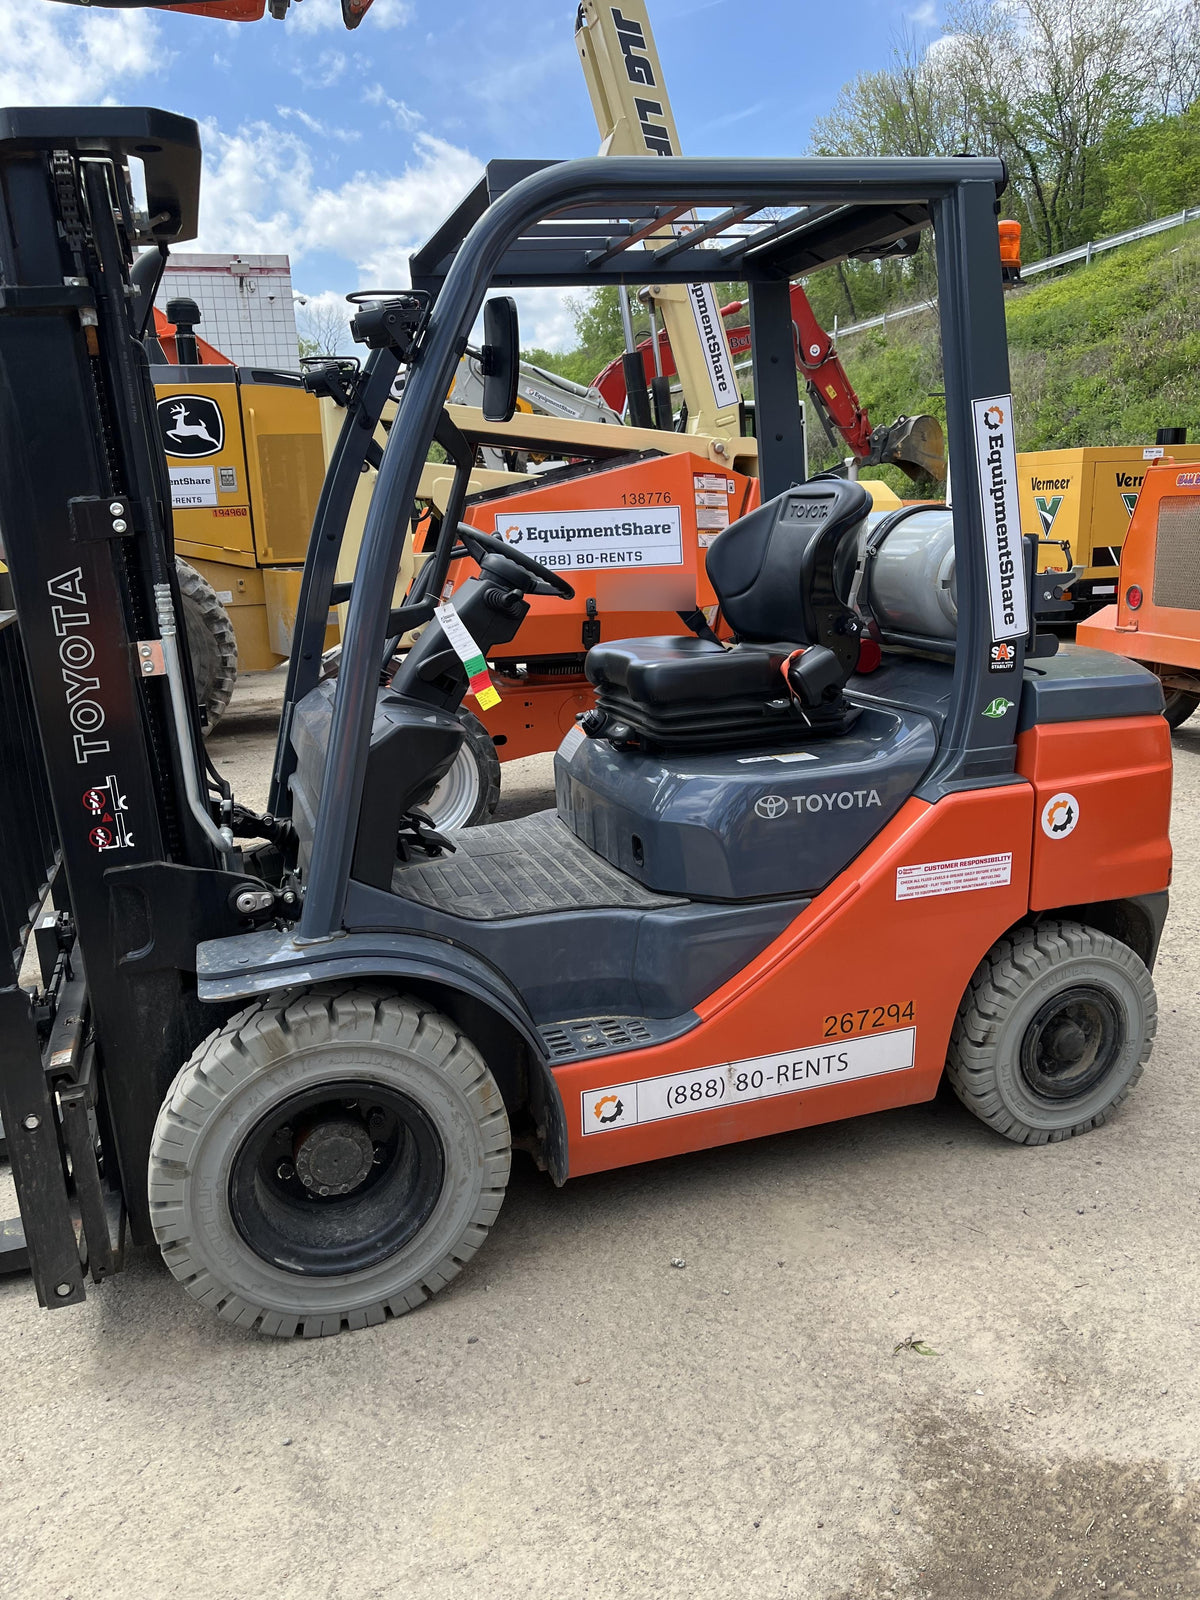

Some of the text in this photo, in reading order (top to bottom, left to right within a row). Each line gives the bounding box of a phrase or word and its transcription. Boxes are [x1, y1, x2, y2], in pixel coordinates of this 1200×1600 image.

[610, 6, 657, 88] JLG
[1031, 477, 1070, 491] Vermeer
[621, 491, 672, 505] 138776
[790, 504, 828, 518] TOYOTA
[526, 522, 672, 543] EquipmentShare
[987, 433, 1016, 626] EquipmentShare
[576, 551, 643, 564] 80-RENTS
[990, 643, 1015, 661] SAS
[48, 566, 110, 764] TOYOTA
[792, 790, 882, 814] TOYOTA
[924, 855, 1011, 872] CUSTOMER RESPONSIBILITY
[824, 1001, 915, 1037] 267294
[666, 1052, 848, 1108] (888) 80-RENTS
